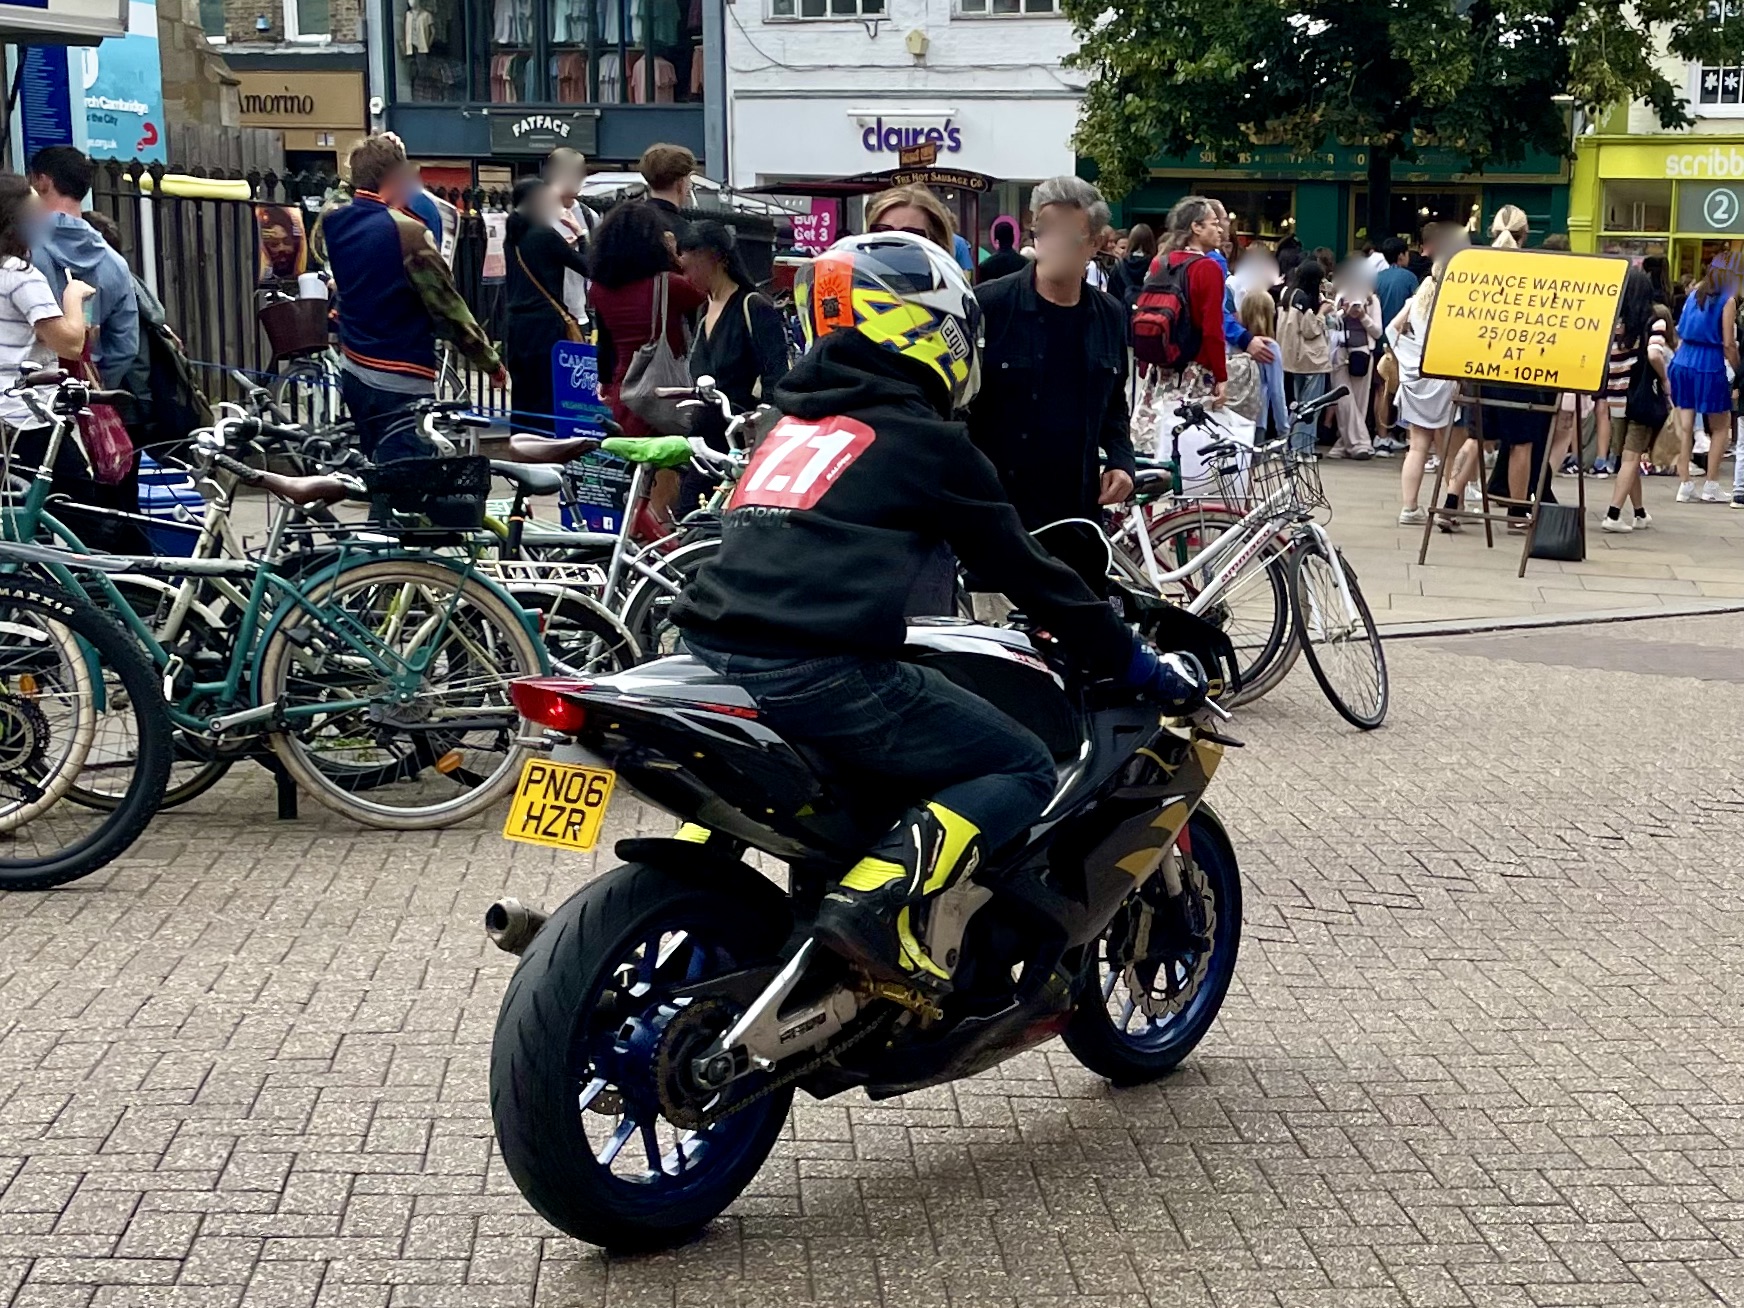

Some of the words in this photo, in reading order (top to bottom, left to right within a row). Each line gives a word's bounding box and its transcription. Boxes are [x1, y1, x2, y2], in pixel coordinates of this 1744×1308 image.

[512, 115, 571, 138] FATFACE
[862, 116, 962, 153] claire's
[895, 175, 911, 185] THE
[912, 172, 929, 182] HOT
[930, 172, 968, 185] SAUSAGE
[1713, 195, 1729, 219] 2
[794, 215, 818, 228] Buy
[821, 211, 830, 226] 3
[794, 226, 816, 241] Get
[819, 227, 829, 242] 3
[1445, 271, 1528, 290] ADVANCE
[1533, 278, 1619, 297] WARNING
[1468, 290, 1521, 306] CYCLE
[1528, 295, 1585, 312] EVENT
[1447, 305, 1509, 323] TAKING
[1514, 311, 1570, 329] PLACE
[1574, 317, 1600, 332] ON
[1477, 326, 1557, 345] 25/08/24
[1503, 347, 1525, 361] AT
[744, 424, 856, 494] 7.1
[0, 588, 75, 615] MAXXIS
[522, 766, 607, 807] PN06
[521, 802, 586, 842] HZR
